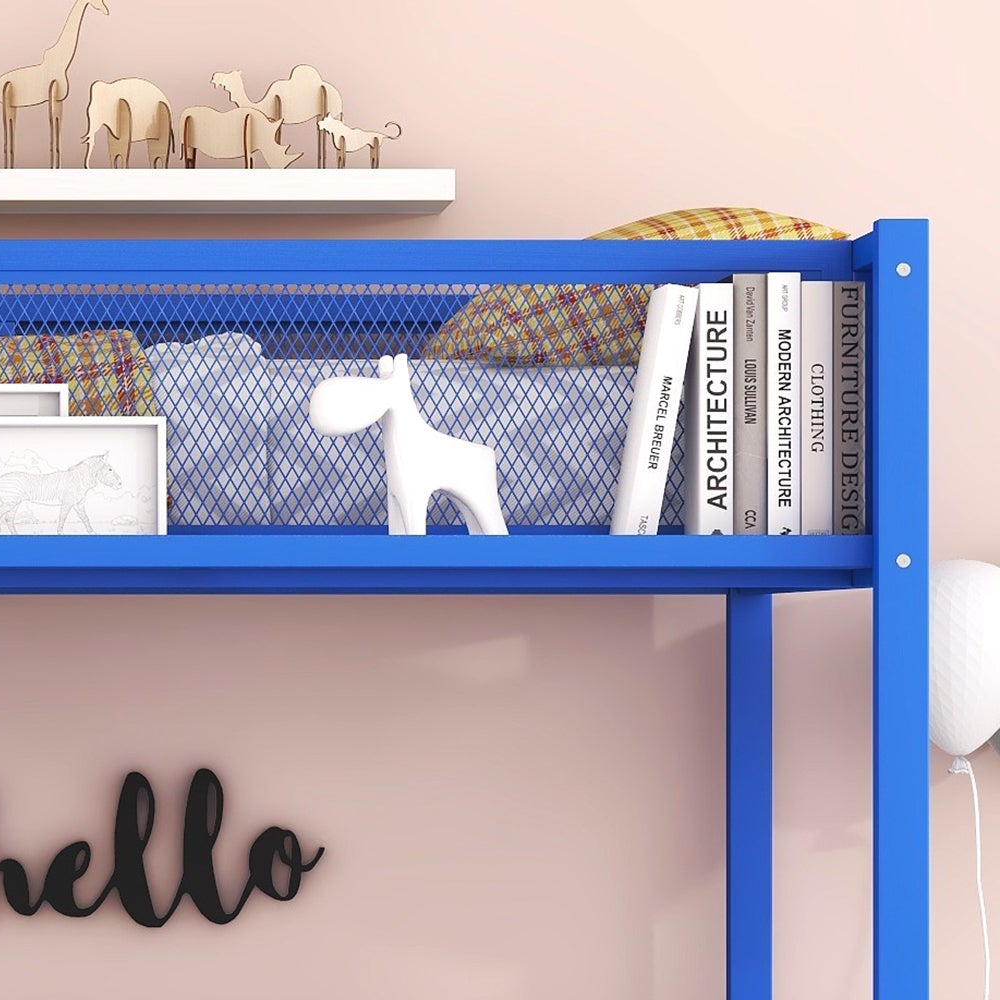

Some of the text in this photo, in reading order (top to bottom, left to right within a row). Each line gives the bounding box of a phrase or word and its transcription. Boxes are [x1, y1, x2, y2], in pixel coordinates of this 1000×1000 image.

[647, 375, 673, 470] MARCEL BREUER
[706, 310, 728, 511] ARCHITECTURE
[744, 359, 757, 425] LOUIS SULLIVAN
[778, 329, 792, 508] MODERN ARCHITECTURE
[811, 363, 825, 453] CLOTHING
[841, 286, 859, 535] FURNITURE DESIG
